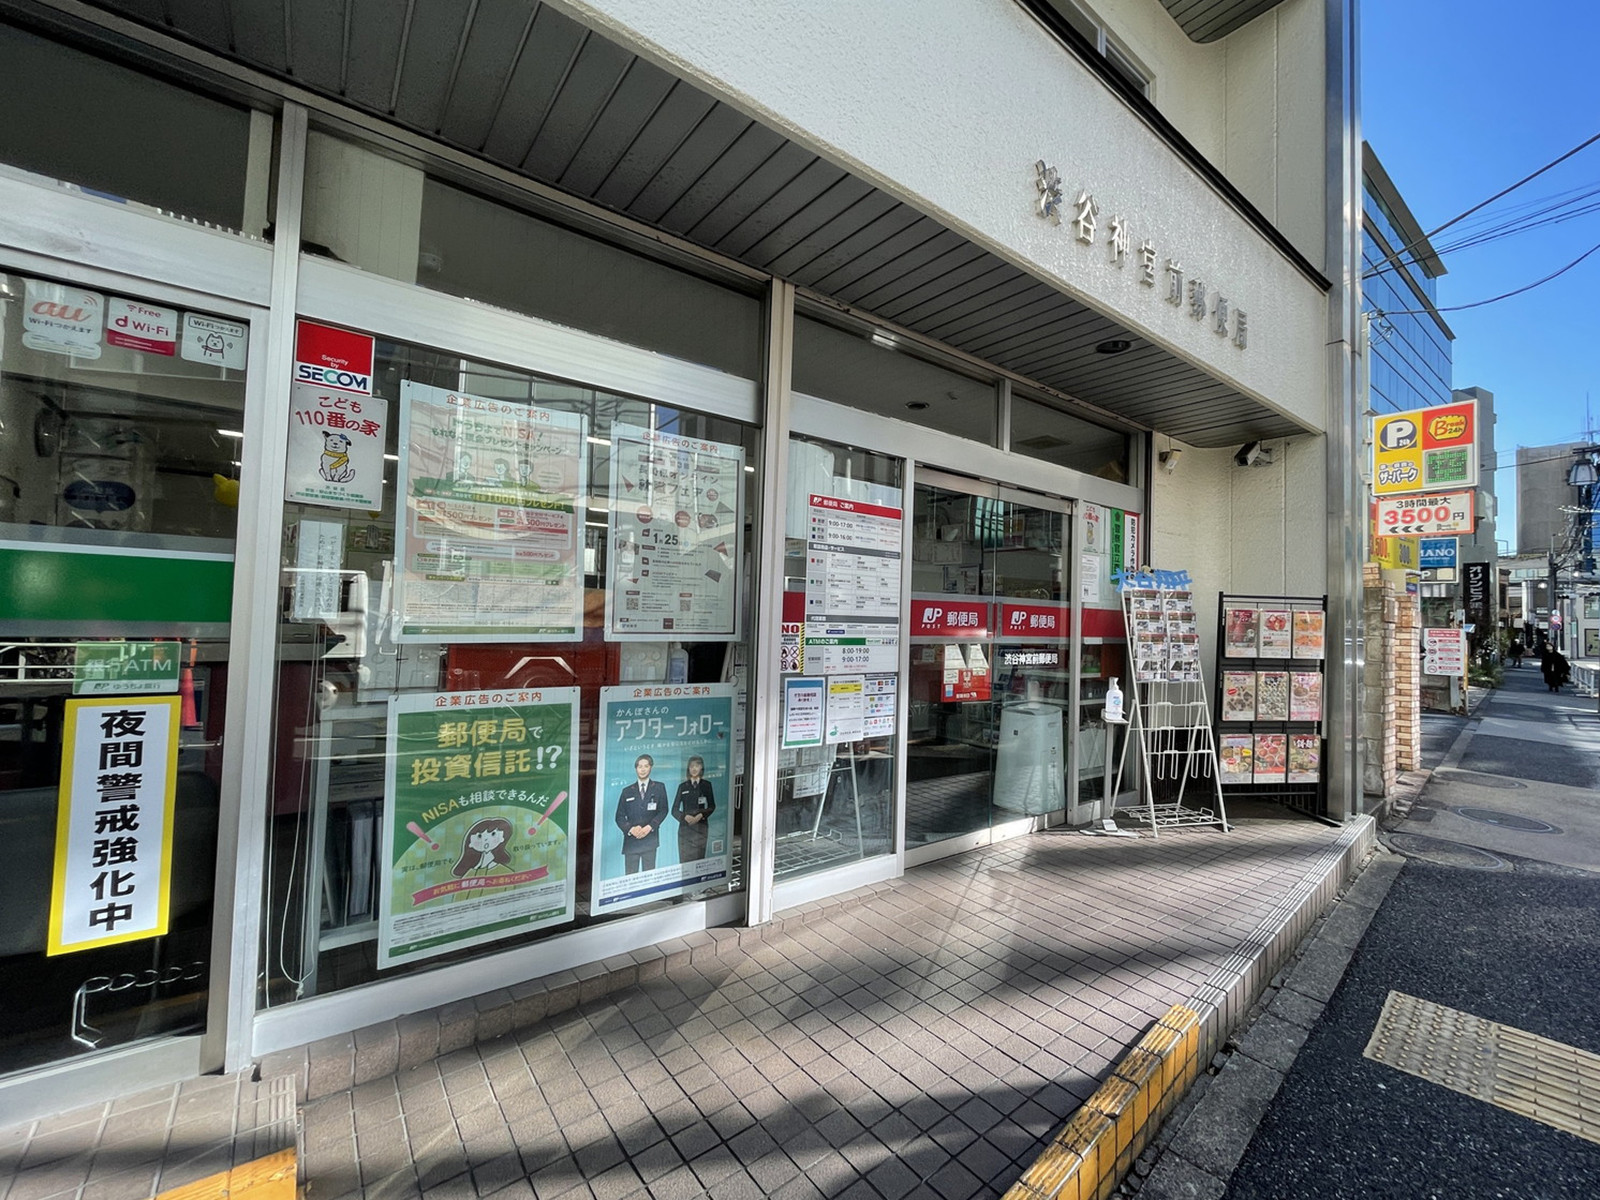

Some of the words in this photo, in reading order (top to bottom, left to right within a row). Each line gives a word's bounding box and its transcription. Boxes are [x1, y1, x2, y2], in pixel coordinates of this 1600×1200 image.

[32, 301, 91, 321] au
[138, 306, 162, 318] Free
[28, 316, 94, 334] Wi-Fiつかえます
[132, 320, 169, 336] Wi-Fi
[321, 354, 348, 366] Security
[299, 365, 367, 390] SECOM
[318, 397, 362, 414] こども
[446, 394, 550, 421] 企業広告のご案内
[295, 410, 380, 437] 110番の家
[642, 432, 719, 453] 企業広告のご案内
[1387, 421, 1413, 448] P
[1379, 468, 1418, 485] ザ・パーク
[1396, 497, 1451, 509] 3時間最大
[946, 611, 979, 627] 郵便局
[1029, 615, 1056, 629] 郵便局
[781, 624, 800, 634] NO
[1004, 653, 1058, 665] 渋谷神宮前郵便局
[435, 692, 543, 707] 企業広告のご案内
[633, 686, 711, 697] 企業広告のご案内
[615, 706, 669, 717] かんぽさんの
[437, 718, 544, 749] 郵便局で
[615, 714, 724, 742] アフターフォロー
[411, 744, 563, 786] 投資信託!?
[421, 789, 550, 824] NISAも相談できるんだ
[89, 709, 147, 932] 夜間警戒強化中
